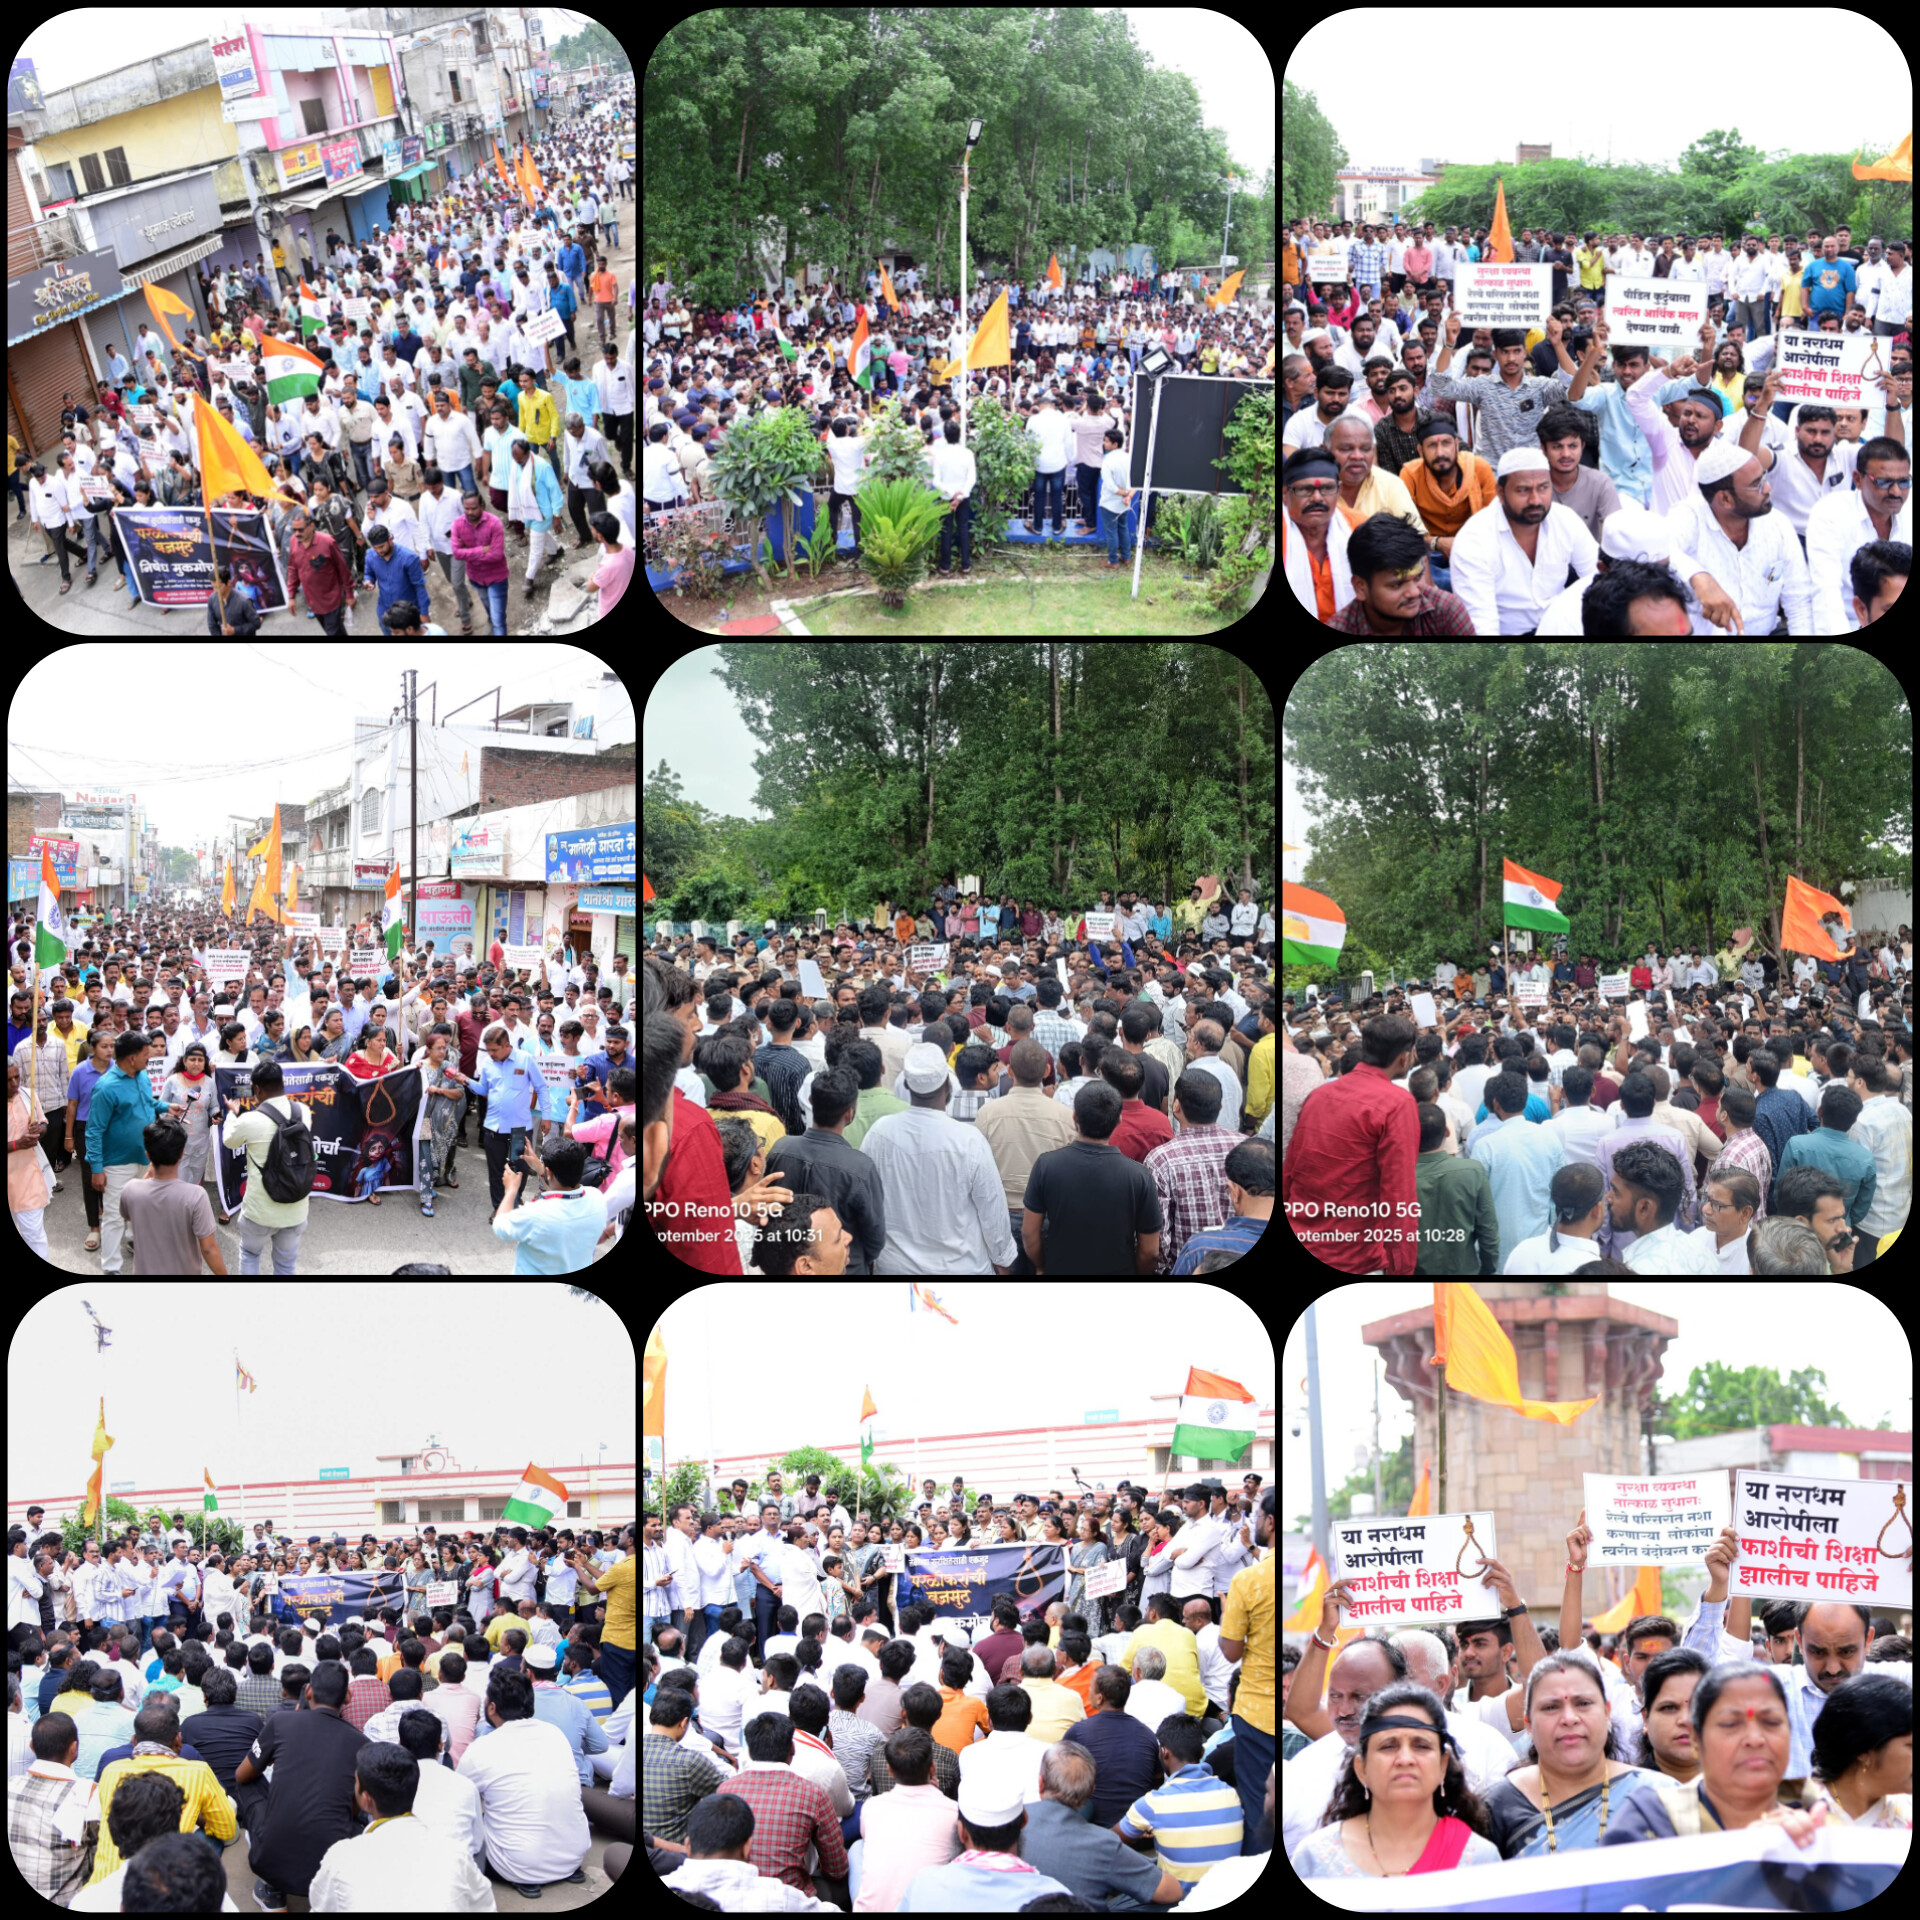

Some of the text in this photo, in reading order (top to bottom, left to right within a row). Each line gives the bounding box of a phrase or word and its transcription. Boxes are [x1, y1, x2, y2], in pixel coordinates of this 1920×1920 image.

[212, 36, 247, 57] महेश
[1485, 288, 1521, 299] परिसरात
[1523, 290, 1540, 299] नशा
[1623, 287, 1691, 306] पीडित कुटुंबाला
[1612, 305, 1641, 317] त्वरित
[1643, 305, 1676, 319] आर्थिक
[1626, 321, 1656, 335] देण्यात
[1784, 335, 1844, 351] या नराधम
[1782, 350, 1840, 367] आरोपीला
[1831, 368, 1862, 385] शिक्षा
[1825, 386, 1862, 402] पाहिजे
[139, 559, 170, 574] निषेध
[568, 836, 597, 859] मातोश्री
[354, 861, 390, 878] तुळजाई
[583, 887, 614, 907] मातोश्री
[419, 904, 472, 925] माऊली
[315, 1073, 340, 1086] एकजुट
[1616, 1480, 1697, 1496] सुरक्षा व्यवस्था
[1745, 1481, 1846, 1507] या नराधम
[1613, 1498, 1658, 1509] तात्काळ
[1606, 1509, 1712, 1524] रेल्वे परिसरात नशा
[1743, 1506, 1840, 1535] आरोपीला
[1341, 1525, 1426, 1545] या नराधम
[1667, 1525, 1714, 1540] लोकांचा
[1344, 1546, 1424, 1569] आरोपीला
[1602, 1543, 1638, 1556] त्वरीत
[1741, 1535, 1880, 1566] फाशीची शिक्षा
[910, 1567, 987, 1589] परळीकरांची
[1415, 1567, 1460, 1589] शिक्षा
[1739, 1563, 1880, 1596] झालीच पाहिजे
[925, 1589, 972, 1610] वज्रमुठ
[1348, 1589, 1464, 1620] झालीच पाहिजे
